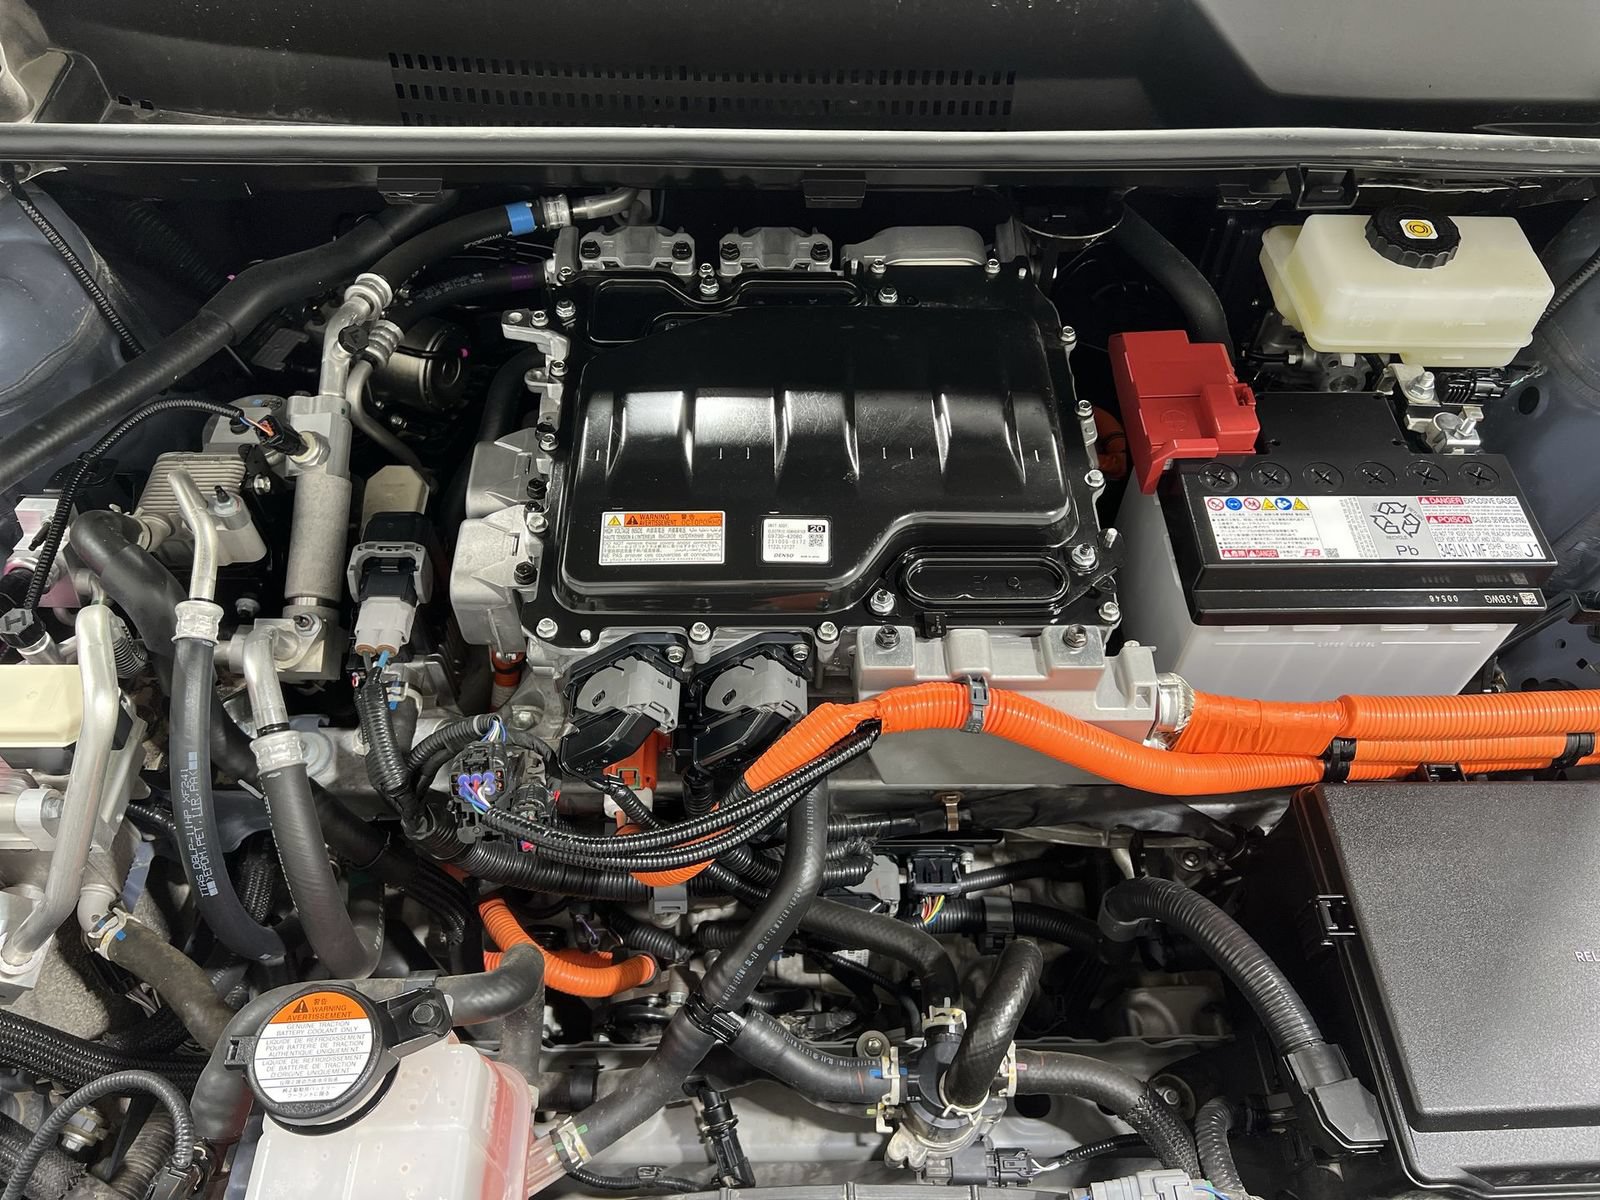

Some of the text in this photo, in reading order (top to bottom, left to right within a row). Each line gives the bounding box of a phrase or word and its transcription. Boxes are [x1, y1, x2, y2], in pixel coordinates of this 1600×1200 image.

[1438, 516, 1471, 524] POISON
[809, 525, 824, 533] 20
[1396, 545, 1419, 556] Pb
[1438, 543, 1487, 557] 345LN1-MF
[1524, 544, 1544, 558] J1
[1484, 595, 1519, 604] 43BWG
[180, 768, 191, 804] XF241
[311, 1004, 347, 1013] WARNING
[286, 1011, 352, 1021] AVERTISSEMENT
[306, 1034, 365, 1043] REFROIDISSEMENT
[332, 1040, 364, 1048] TRACTION
[269, 1046, 359, 1057] AUTHENTIQUE UNIQUEMENT
[303, 1055, 363, 1063] REFROIDISSEMENT
[270, 1067, 350, 1078] D'ORIGINE UNIQUEMENT
